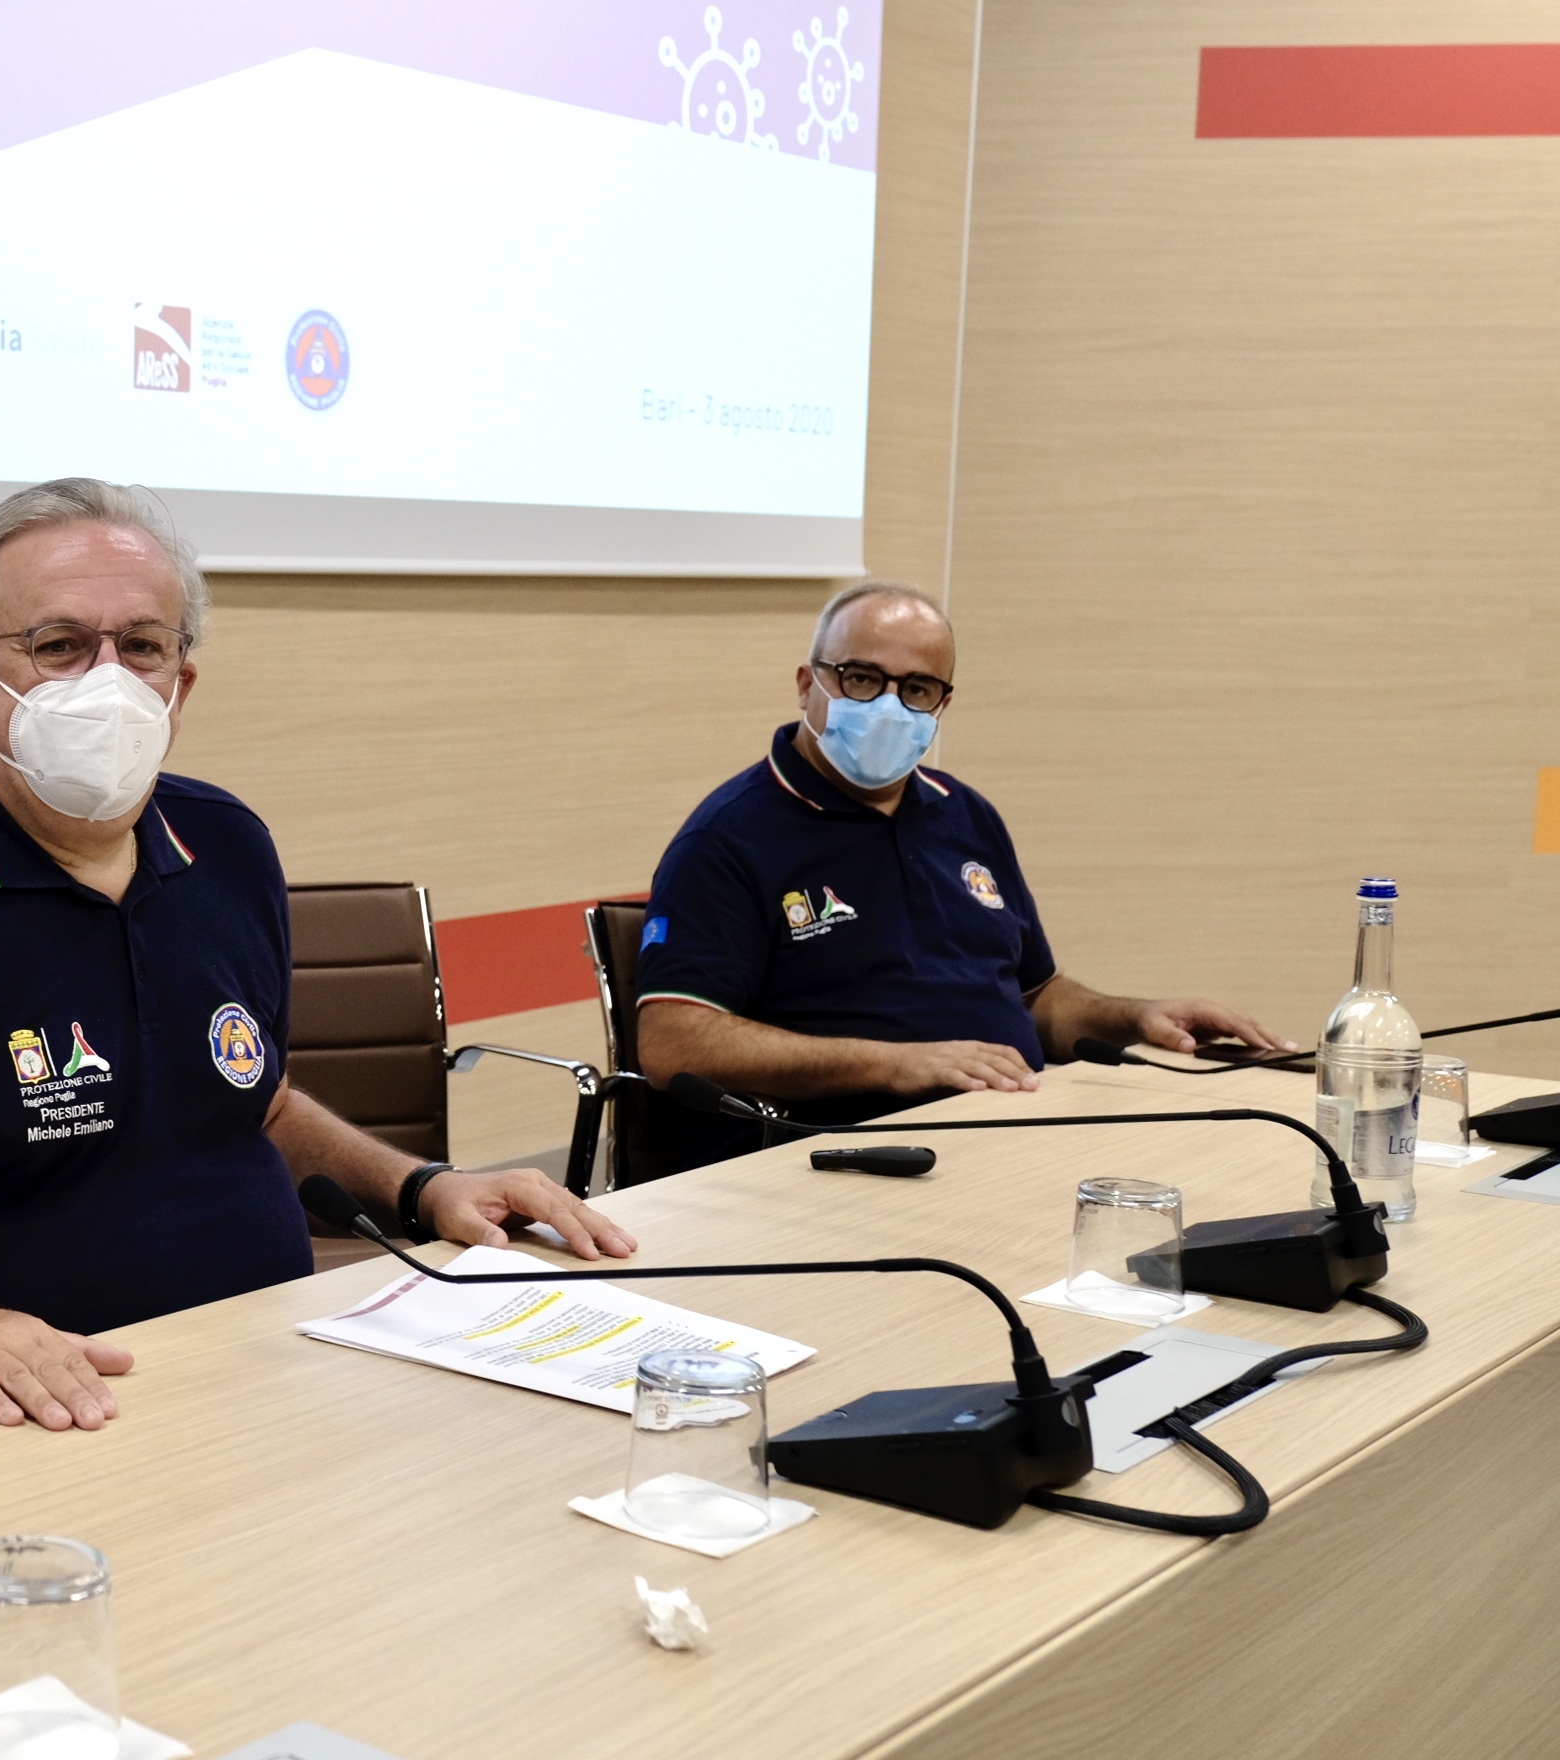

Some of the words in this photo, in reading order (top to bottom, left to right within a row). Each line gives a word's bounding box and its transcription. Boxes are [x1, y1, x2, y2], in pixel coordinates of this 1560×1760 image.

[642, 388, 683, 422] Bari
[720, 404, 784, 436] agosto
[789, 403, 835, 435] 2020
[217, 1056, 248, 1084] REGIONE
[247, 1056, 261, 1081] PUGLIA
[19, 1077, 83, 1097] PROTEZIONE
[84, 1072, 114, 1085] CIVILE
[23, 1095, 54, 1108] Regione
[54, 1090, 77, 1103] Puglia
[40, 1101, 105, 1123] PRESIDENTE
[27, 1124, 72, 1143] Michele
[73, 1119, 115, 1136] Emiliano
